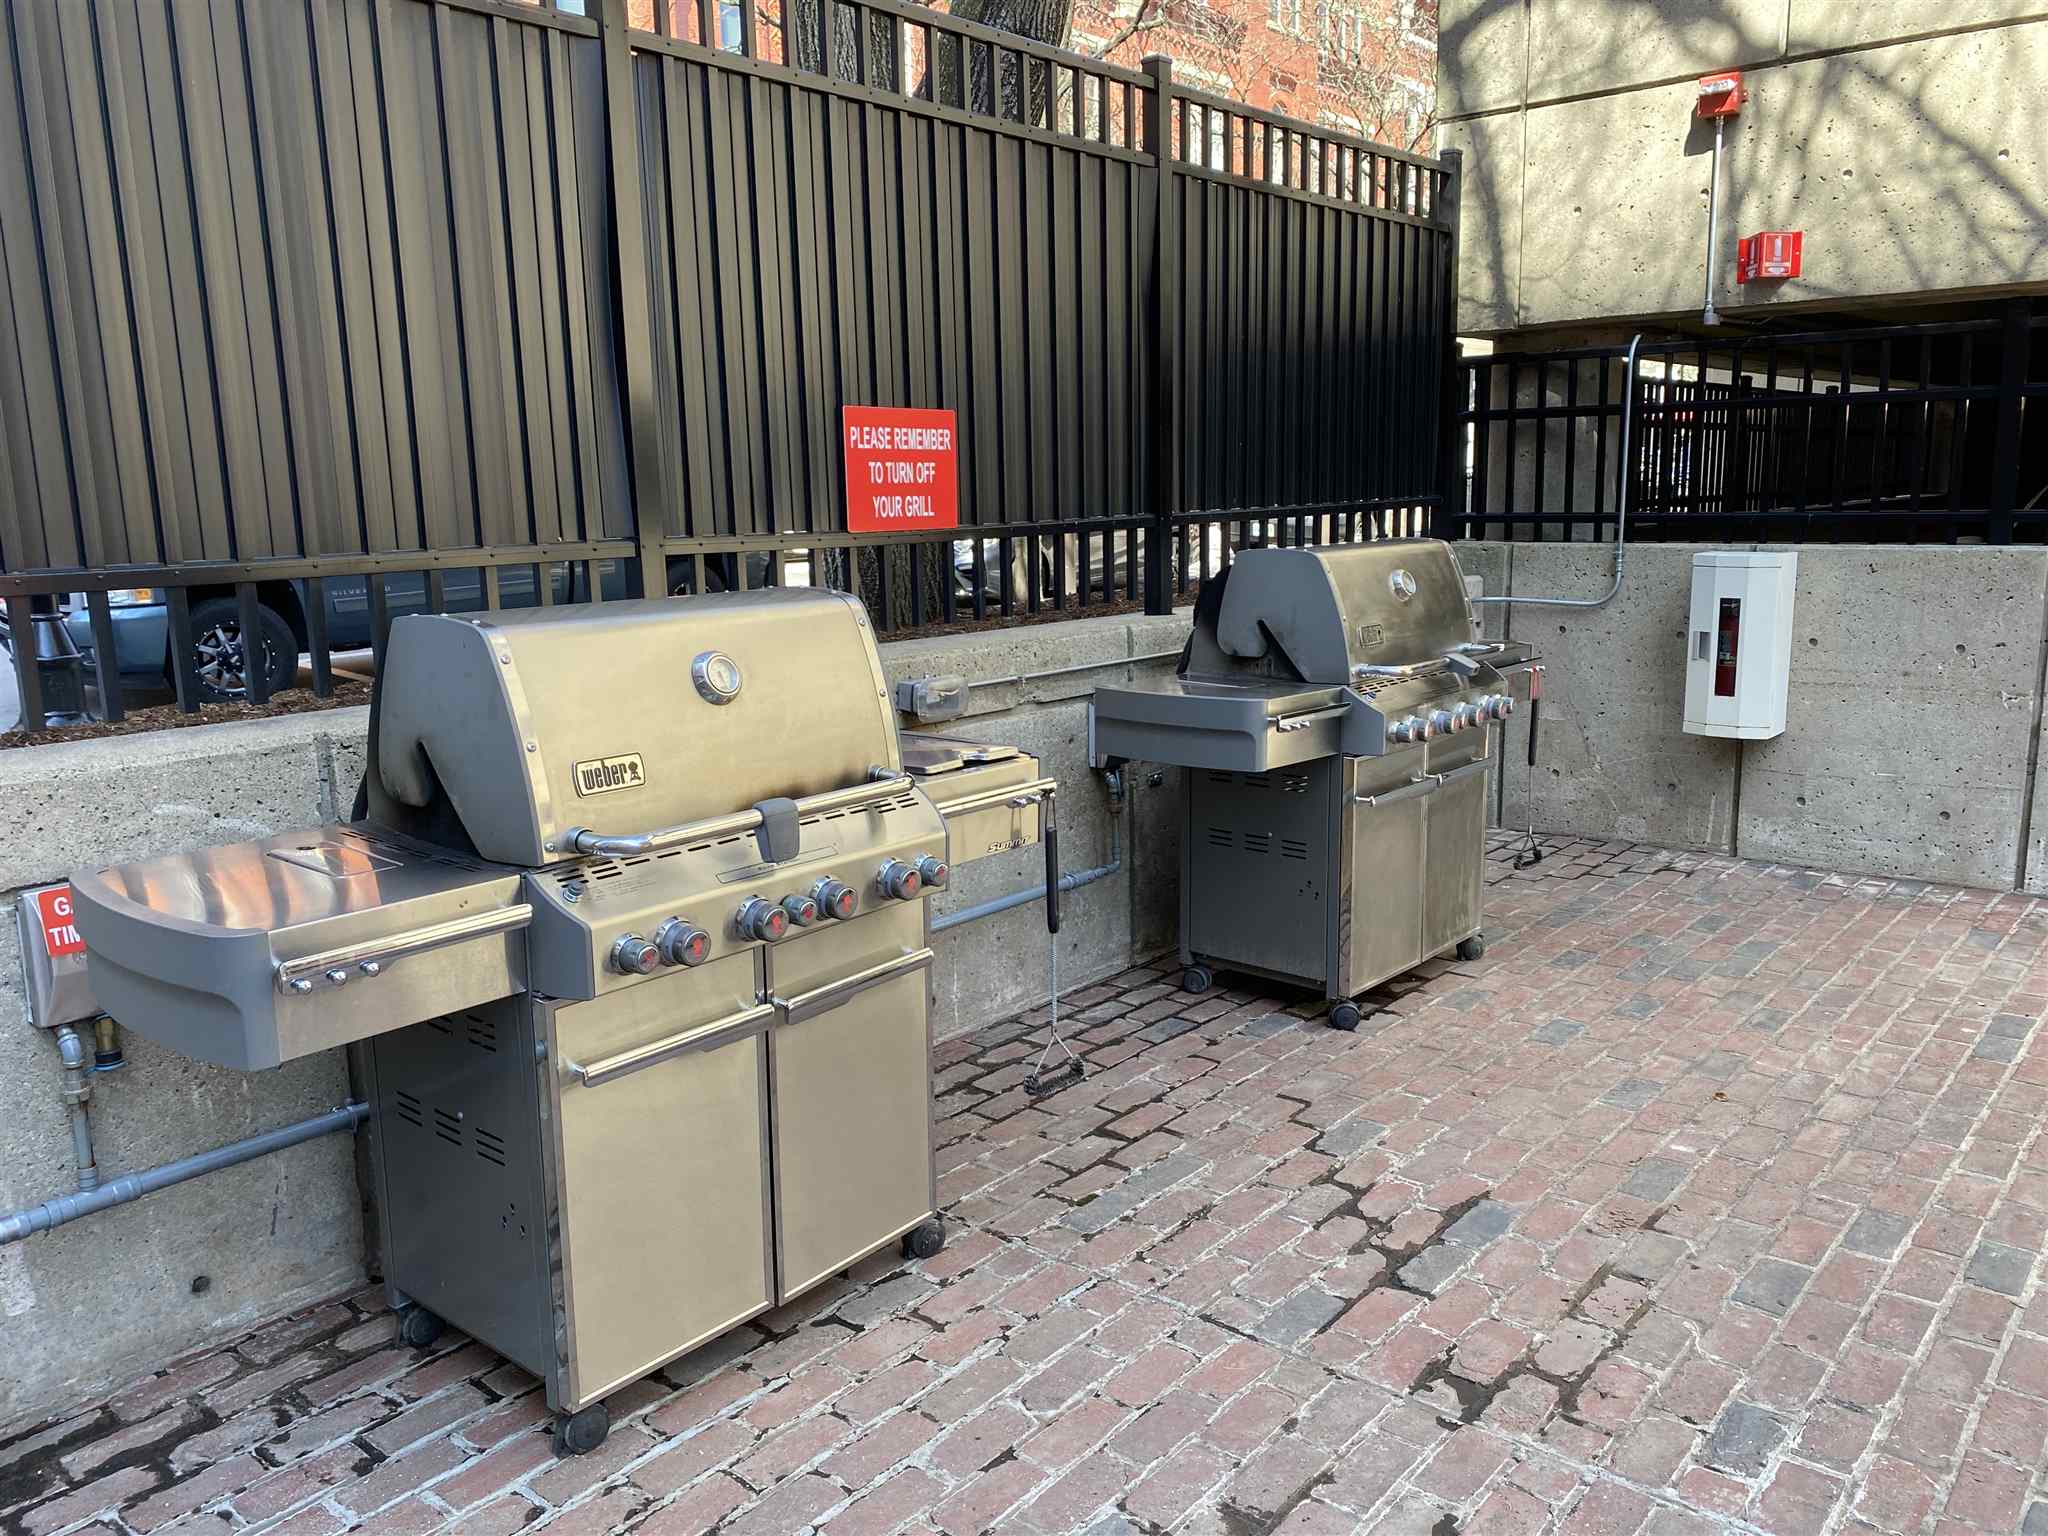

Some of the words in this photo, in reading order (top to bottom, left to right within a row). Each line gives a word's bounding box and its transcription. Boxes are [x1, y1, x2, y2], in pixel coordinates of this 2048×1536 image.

[849, 426, 891, 449] PLEASE
[894, 427, 952, 451] REMEMBER
[868, 461, 884, 484] TO
[886, 461, 914, 484] TURN
[916, 462, 936, 484] OFF
[872, 495, 903, 518] YOUR
[905, 495, 936, 517] GRILL
[581, 759, 628, 790] weber
[53, 896, 74, 916] G
